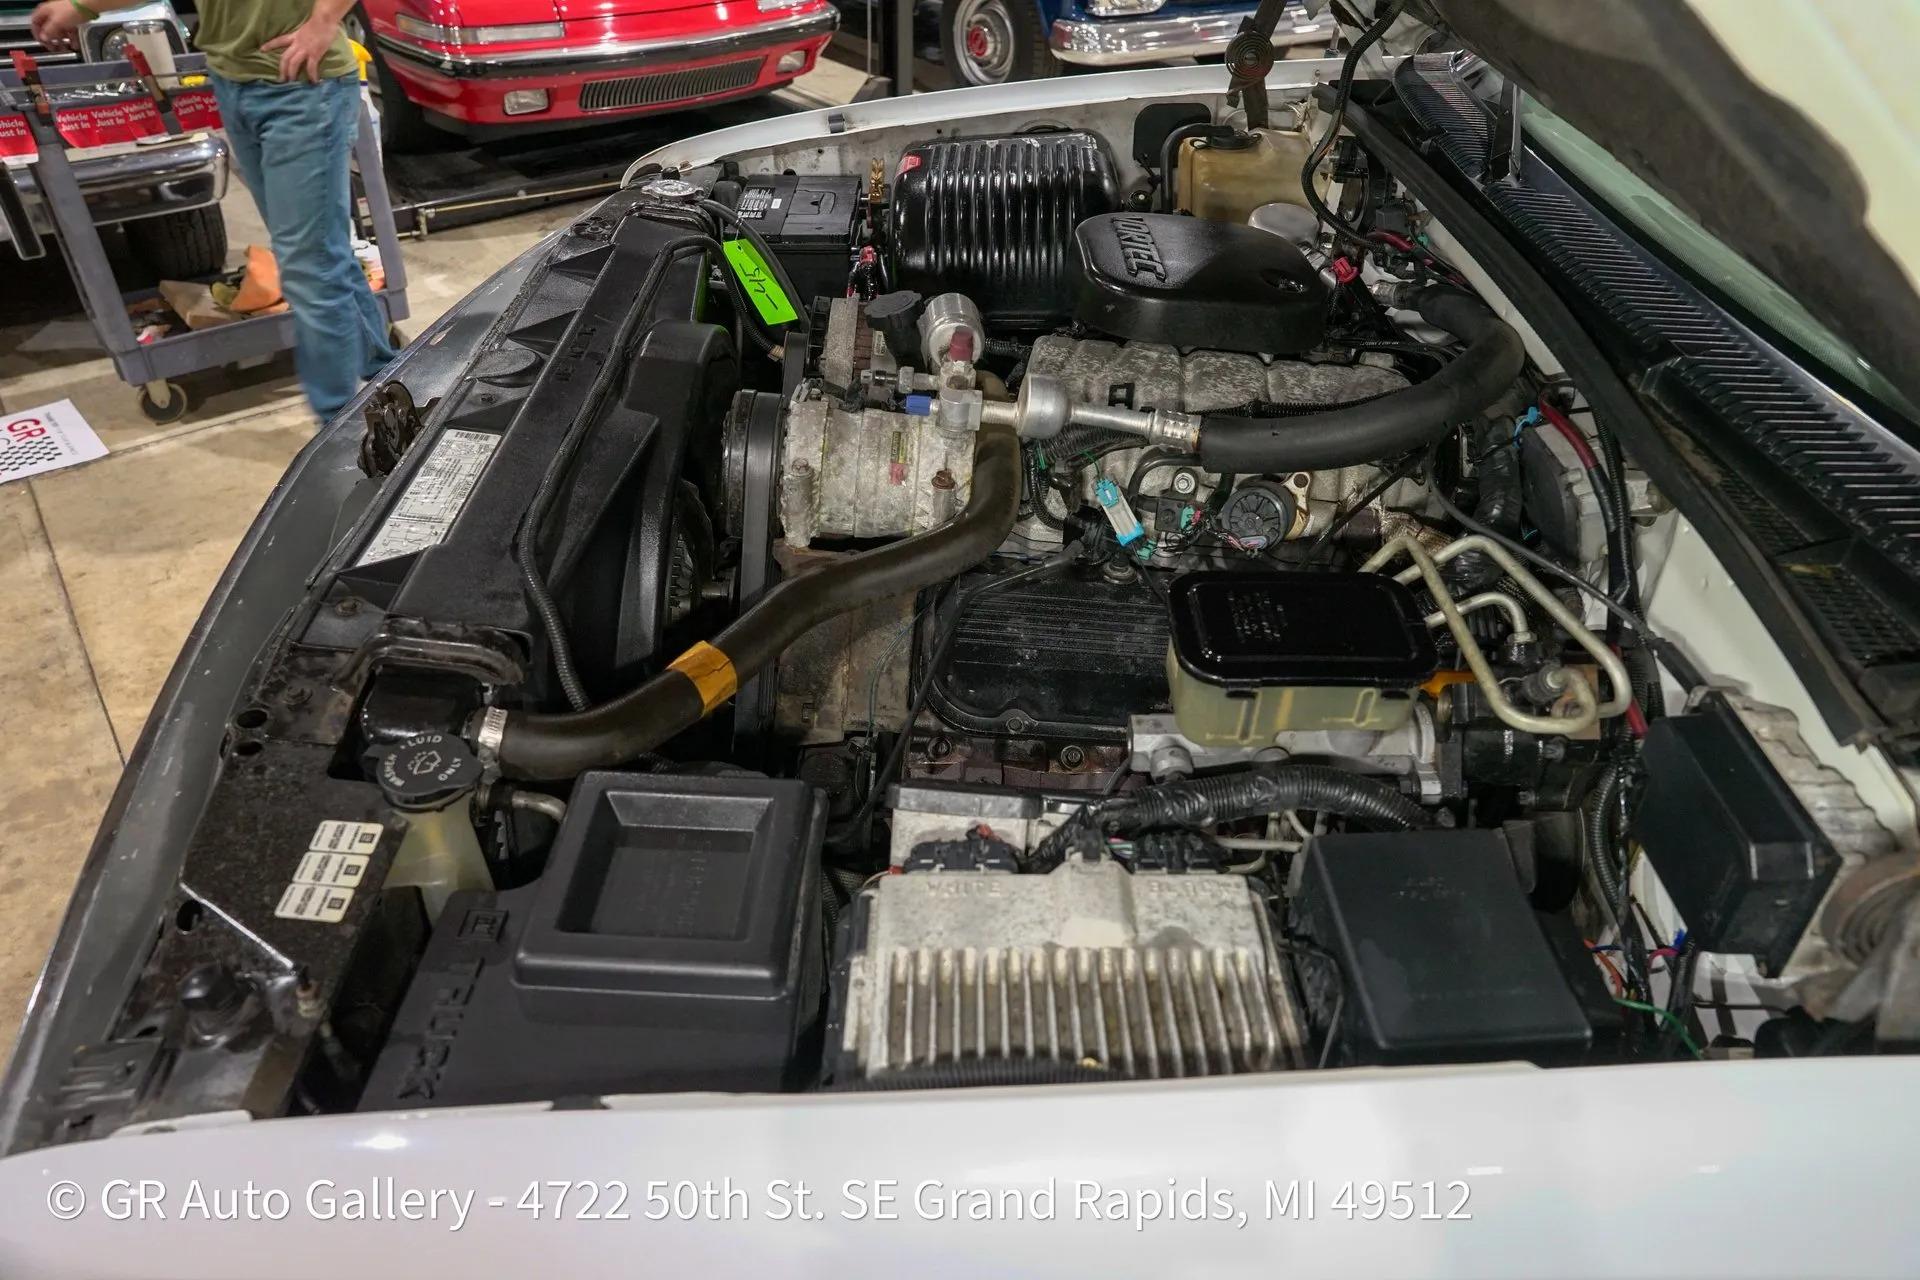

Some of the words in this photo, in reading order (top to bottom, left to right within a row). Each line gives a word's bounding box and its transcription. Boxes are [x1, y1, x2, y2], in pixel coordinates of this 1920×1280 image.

[56, 112, 88, 123] Vehicle
[91, 109, 124, 119] Vehicle
[61, 123, 80, 132] Just
[96, 119, 115, 127] Just
[0, 129, 15, 138] ust
[1111, 216, 1167, 283] VORTEC
[7, 418, 46, 442] GR
